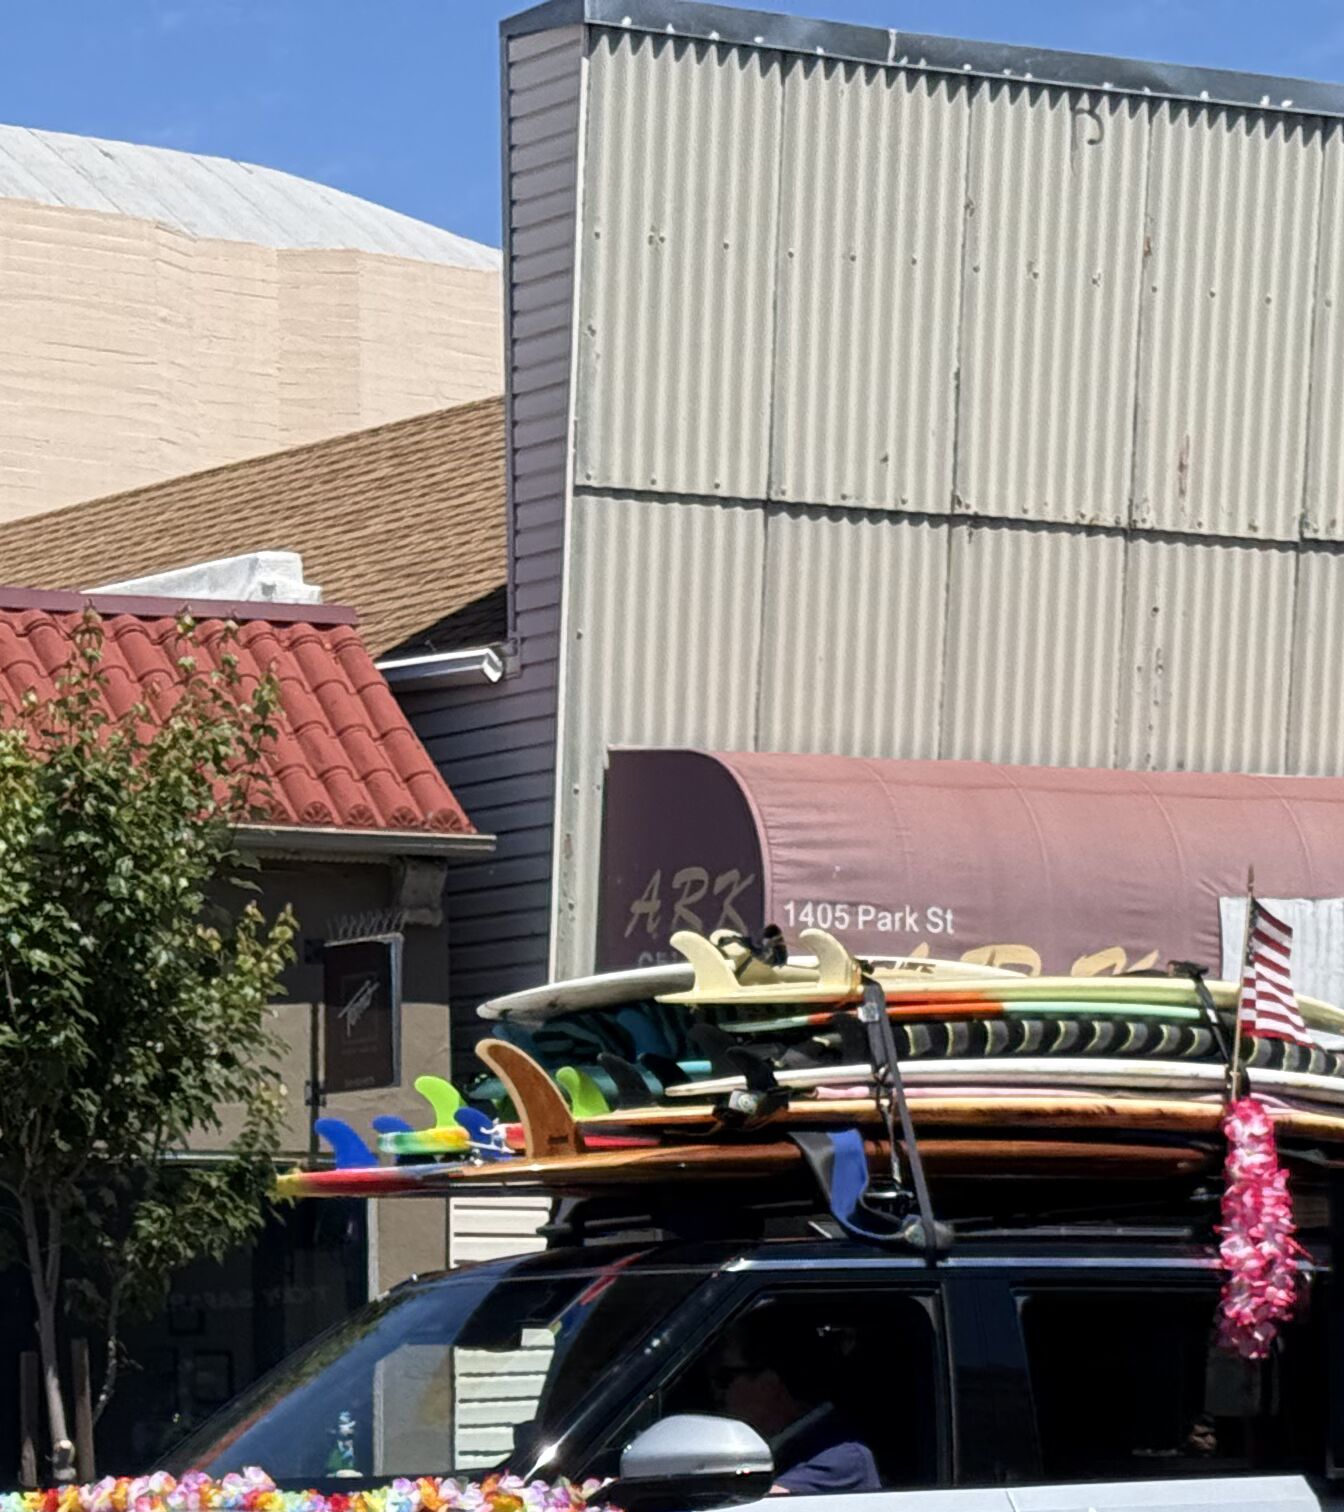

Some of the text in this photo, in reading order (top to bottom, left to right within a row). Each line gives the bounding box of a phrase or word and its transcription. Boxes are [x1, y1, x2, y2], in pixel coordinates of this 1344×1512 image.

[624, 866, 755, 939] ARK
[783, 901, 955, 935] 1405 Park St
